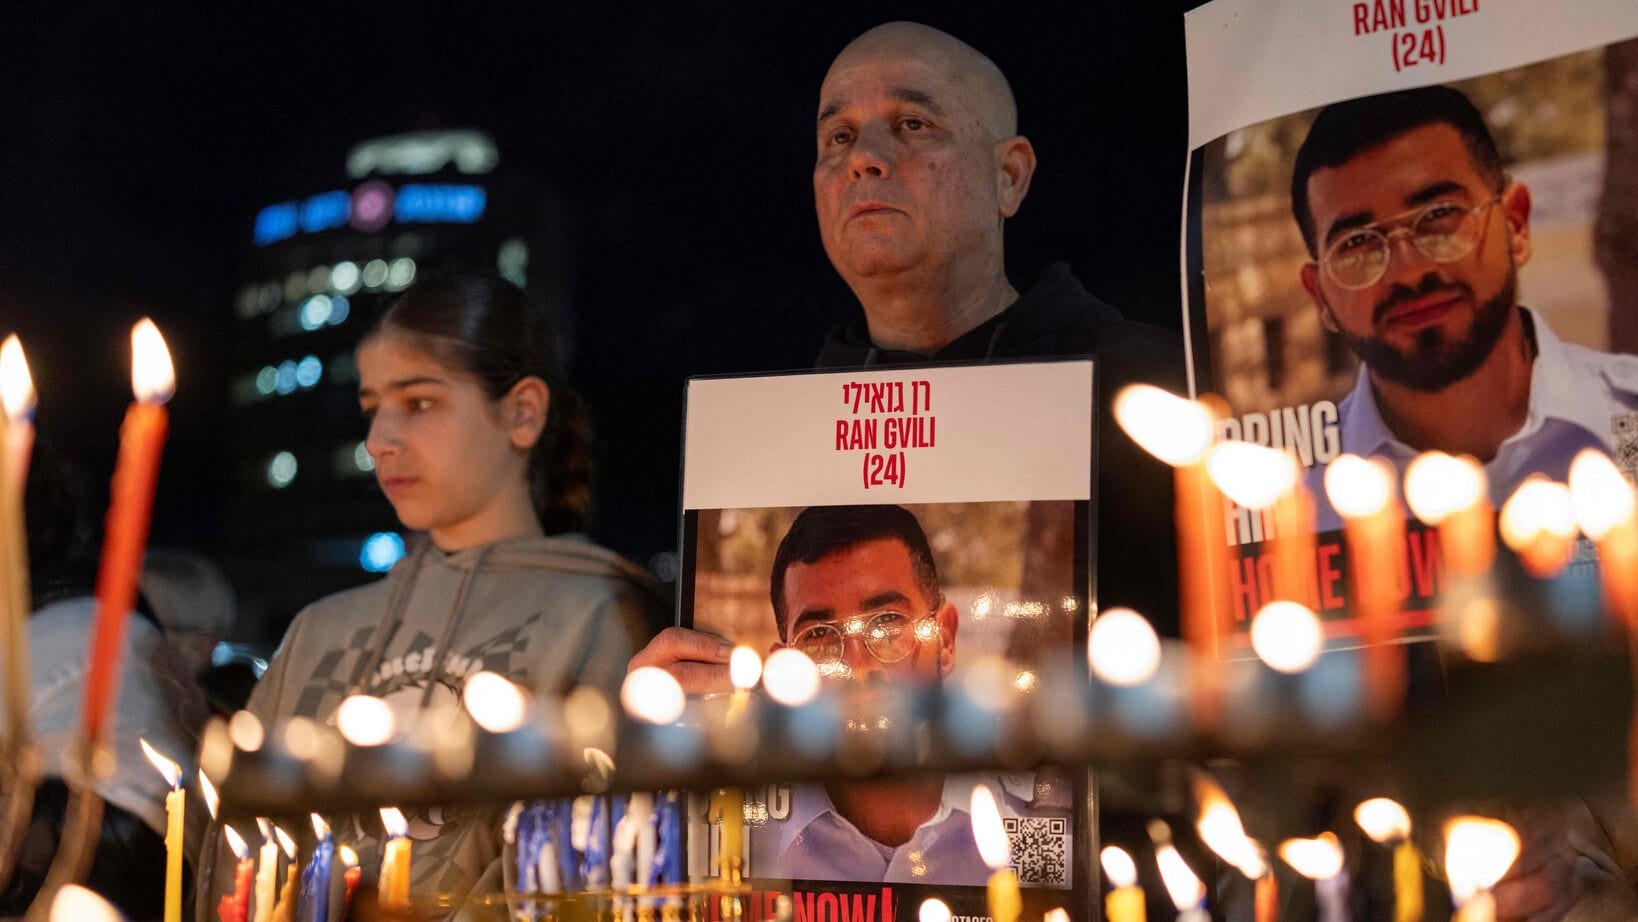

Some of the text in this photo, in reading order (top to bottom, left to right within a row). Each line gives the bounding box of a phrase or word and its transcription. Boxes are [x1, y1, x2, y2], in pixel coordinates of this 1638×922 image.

[1353, 0, 1406, 36] RAN
[1392, 25, 1446, 72] (24)
[842, 380, 931, 415] רן גואילי
[835, 416, 936, 450] RAN GVILI
[862, 451, 906, 489] (24)
[1229, 543, 1346, 622] HOE
